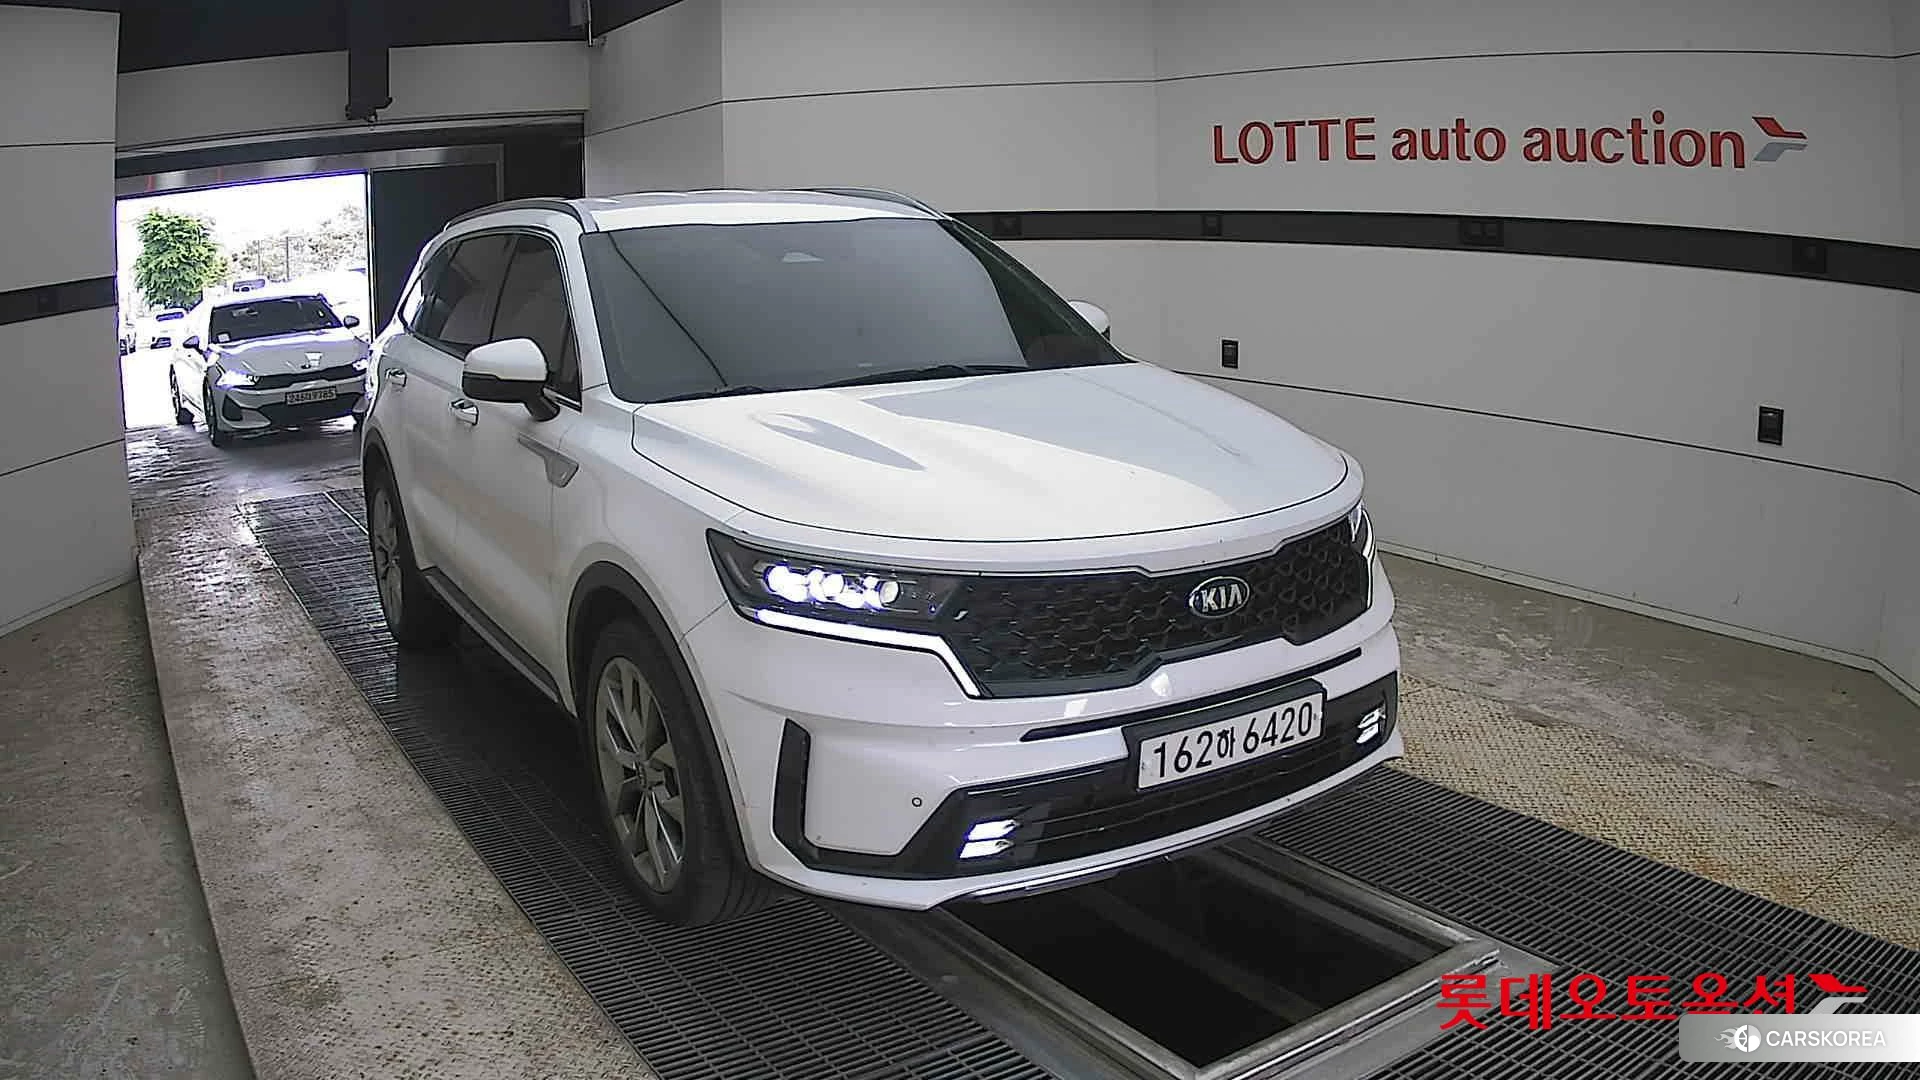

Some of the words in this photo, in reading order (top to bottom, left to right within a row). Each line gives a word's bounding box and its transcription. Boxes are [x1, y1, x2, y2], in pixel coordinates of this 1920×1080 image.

[1213, 117, 1376, 165] LOTTE
[1391, 118, 1507, 161] auto
[1522, 110, 1746, 169] auction
[1200, 583, 1242, 612] KIA
